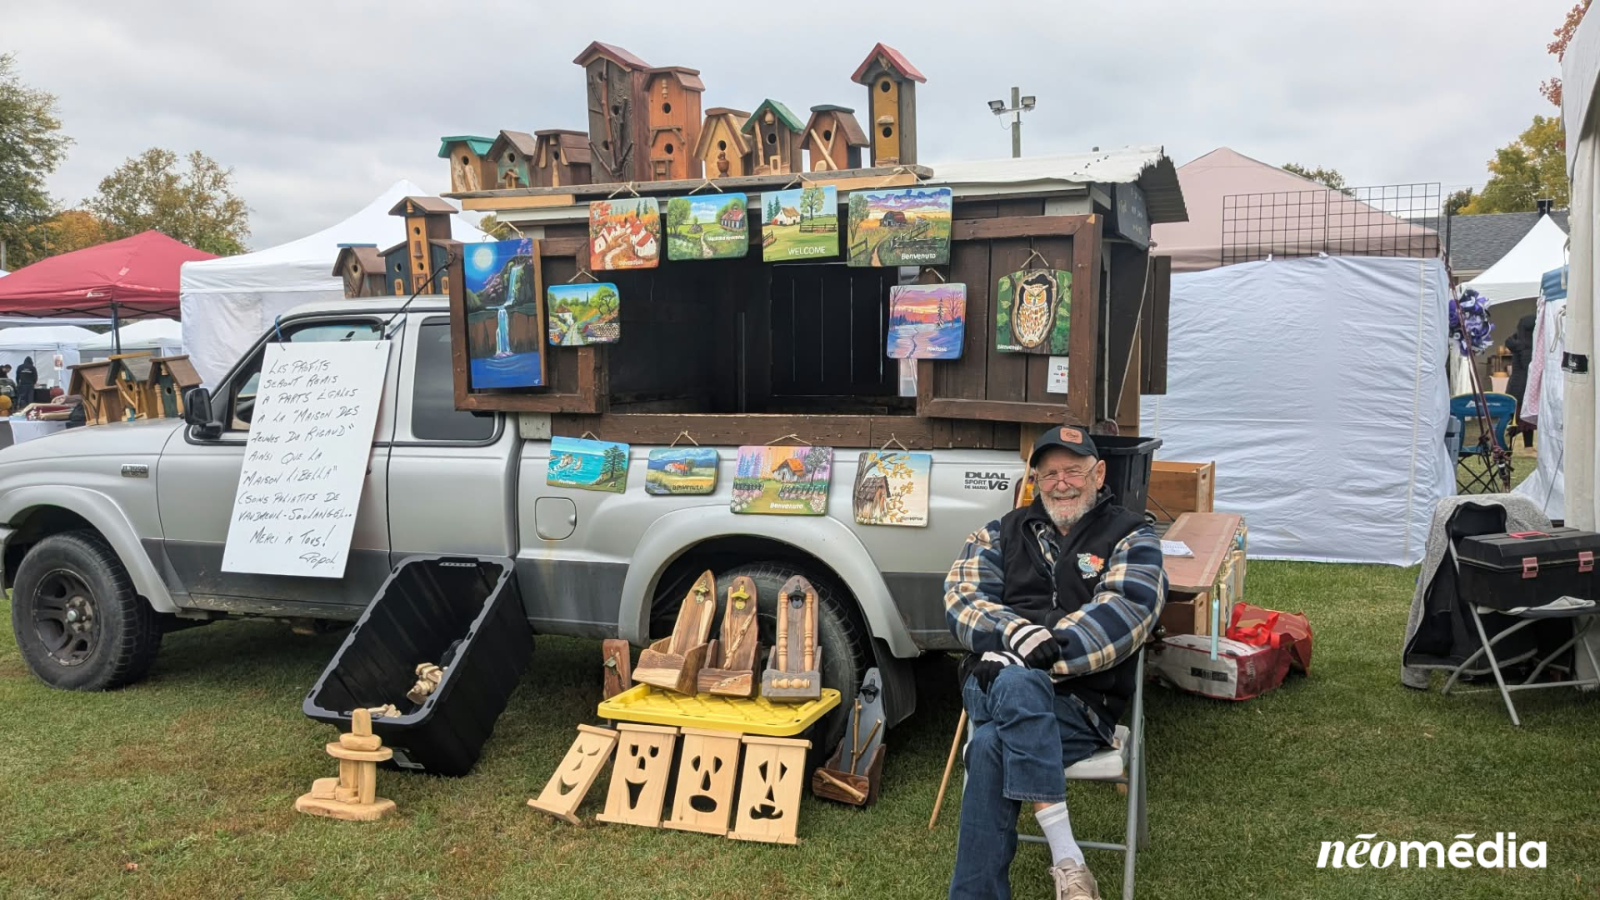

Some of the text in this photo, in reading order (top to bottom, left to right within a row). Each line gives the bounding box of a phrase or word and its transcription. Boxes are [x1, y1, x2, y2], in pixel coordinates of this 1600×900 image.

[787, 246, 826, 256] WELCOME
[269, 359, 331, 374] LES PROFITS
[263, 373, 338, 389] SERONT REMIS
[278, 391, 312, 404] PARTS
[336, 405, 360, 418] DES
[965, 471, 1011, 480] DUAL
[988, 480, 1009, 491] V6
[324, 492, 341, 503] DE
